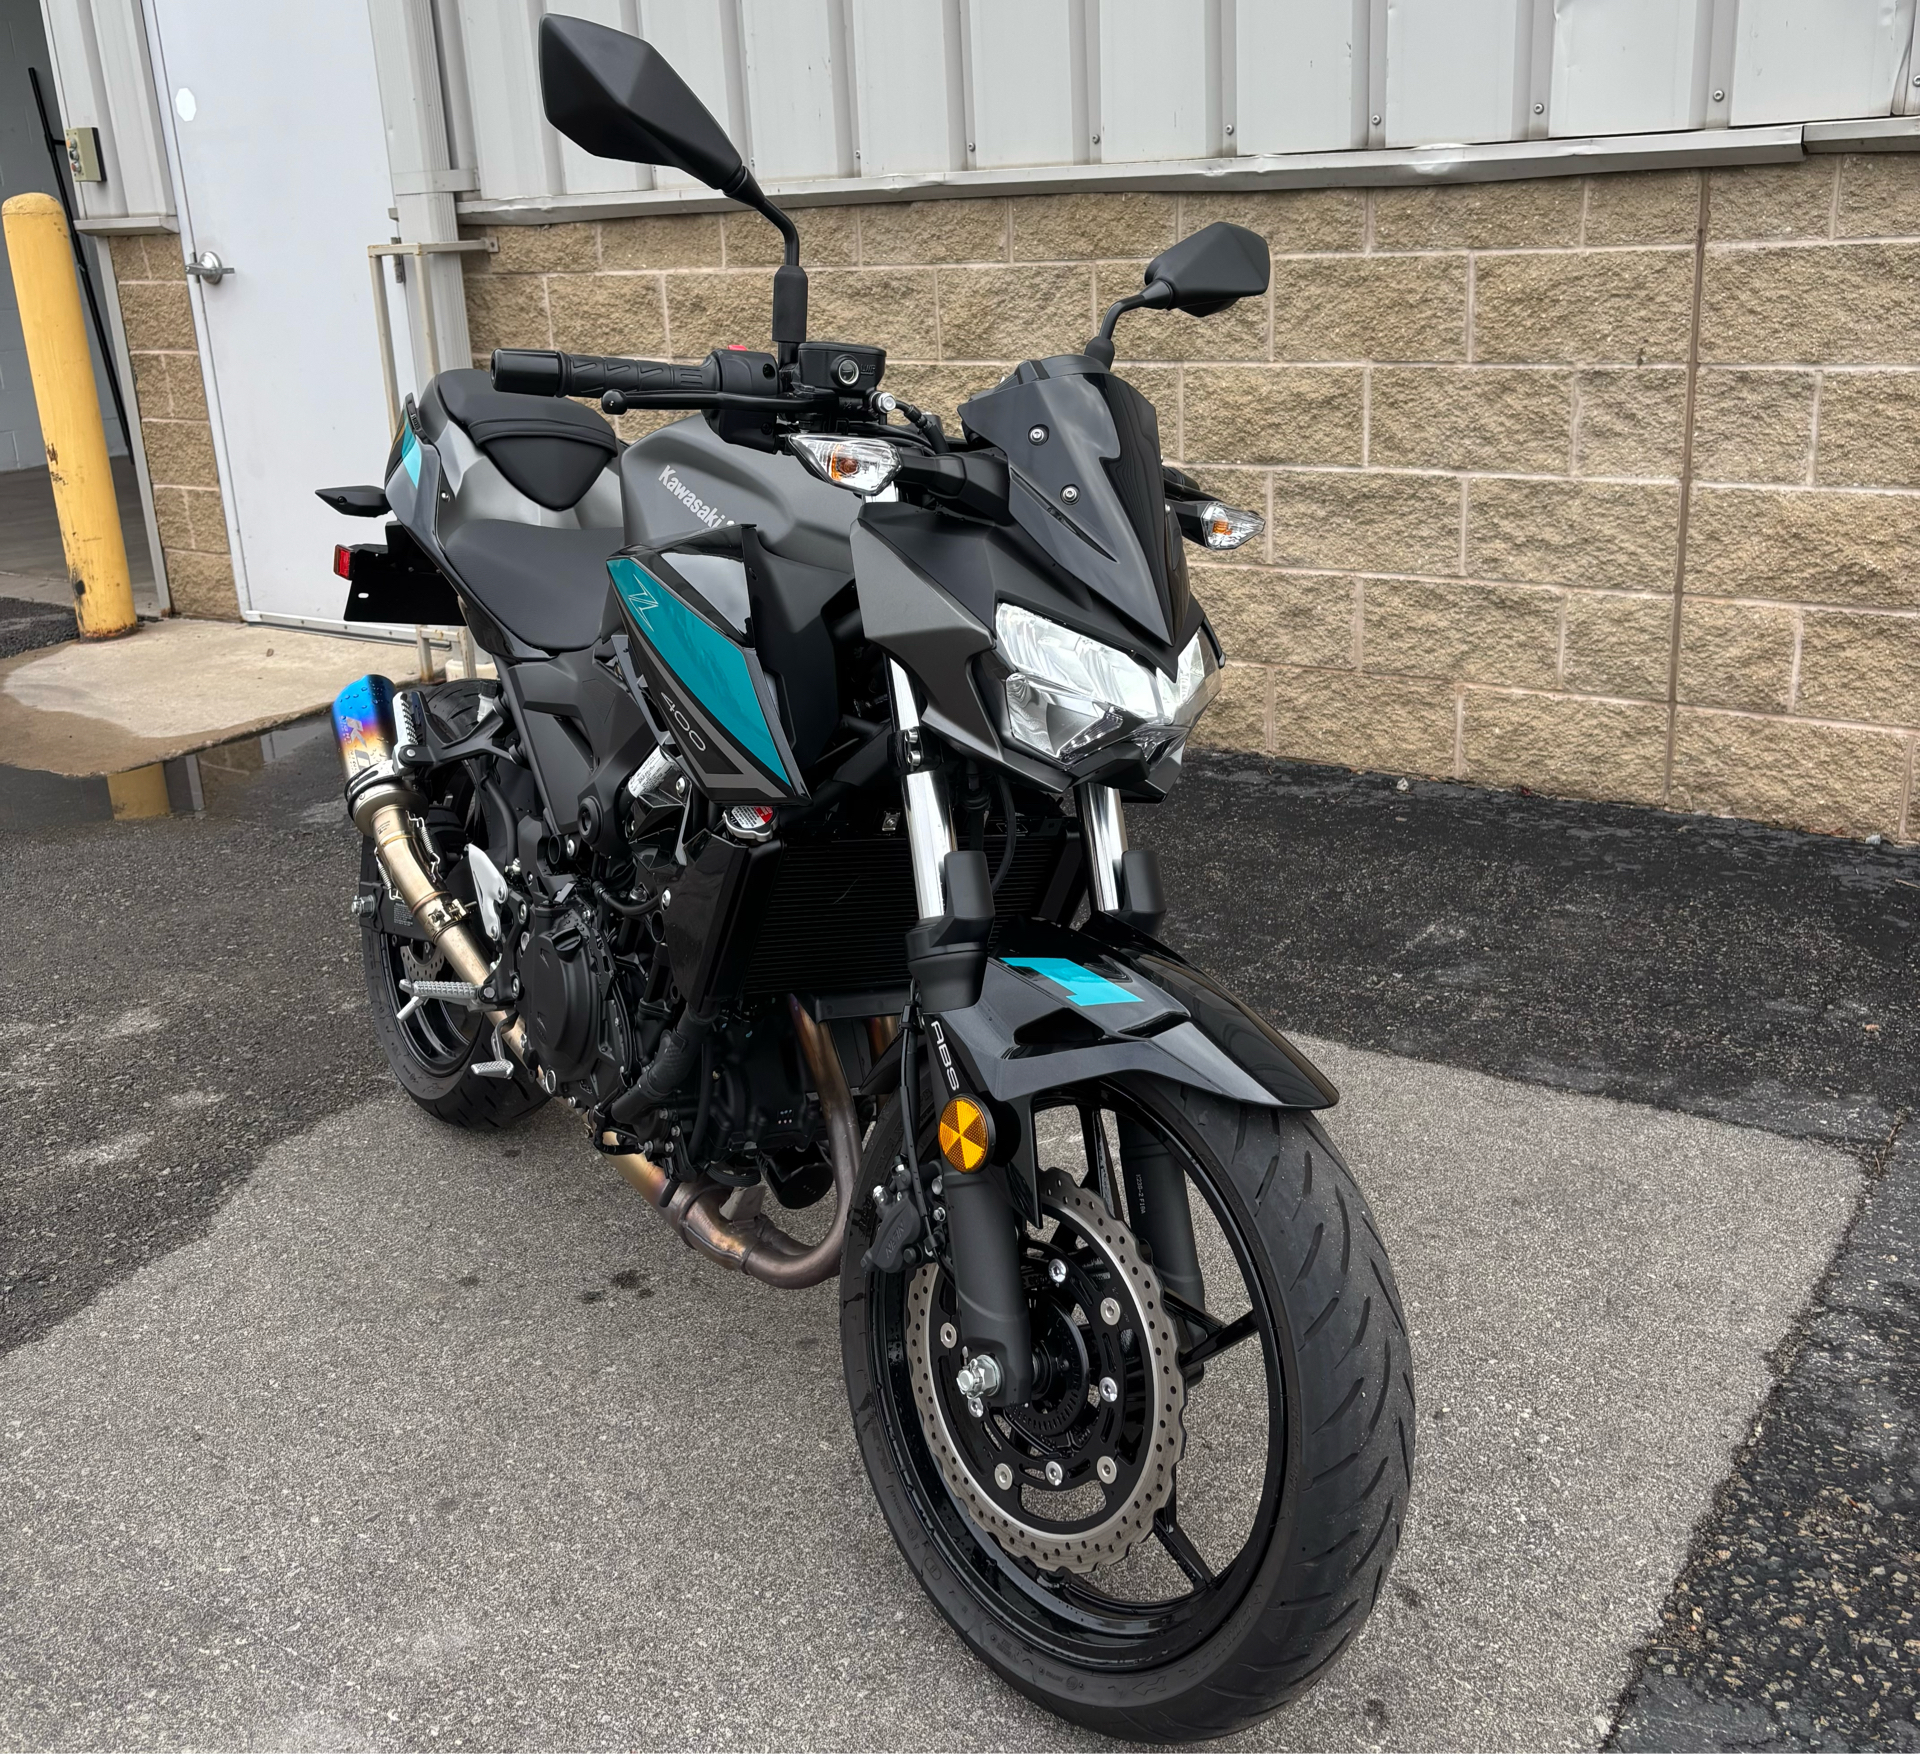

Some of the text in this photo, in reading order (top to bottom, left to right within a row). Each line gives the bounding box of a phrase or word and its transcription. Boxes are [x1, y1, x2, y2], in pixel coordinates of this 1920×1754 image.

[658, 464, 726, 529] Kawasaki
[661, 692, 706, 751] 400
[931, 1020, 960, 1091] ABS
